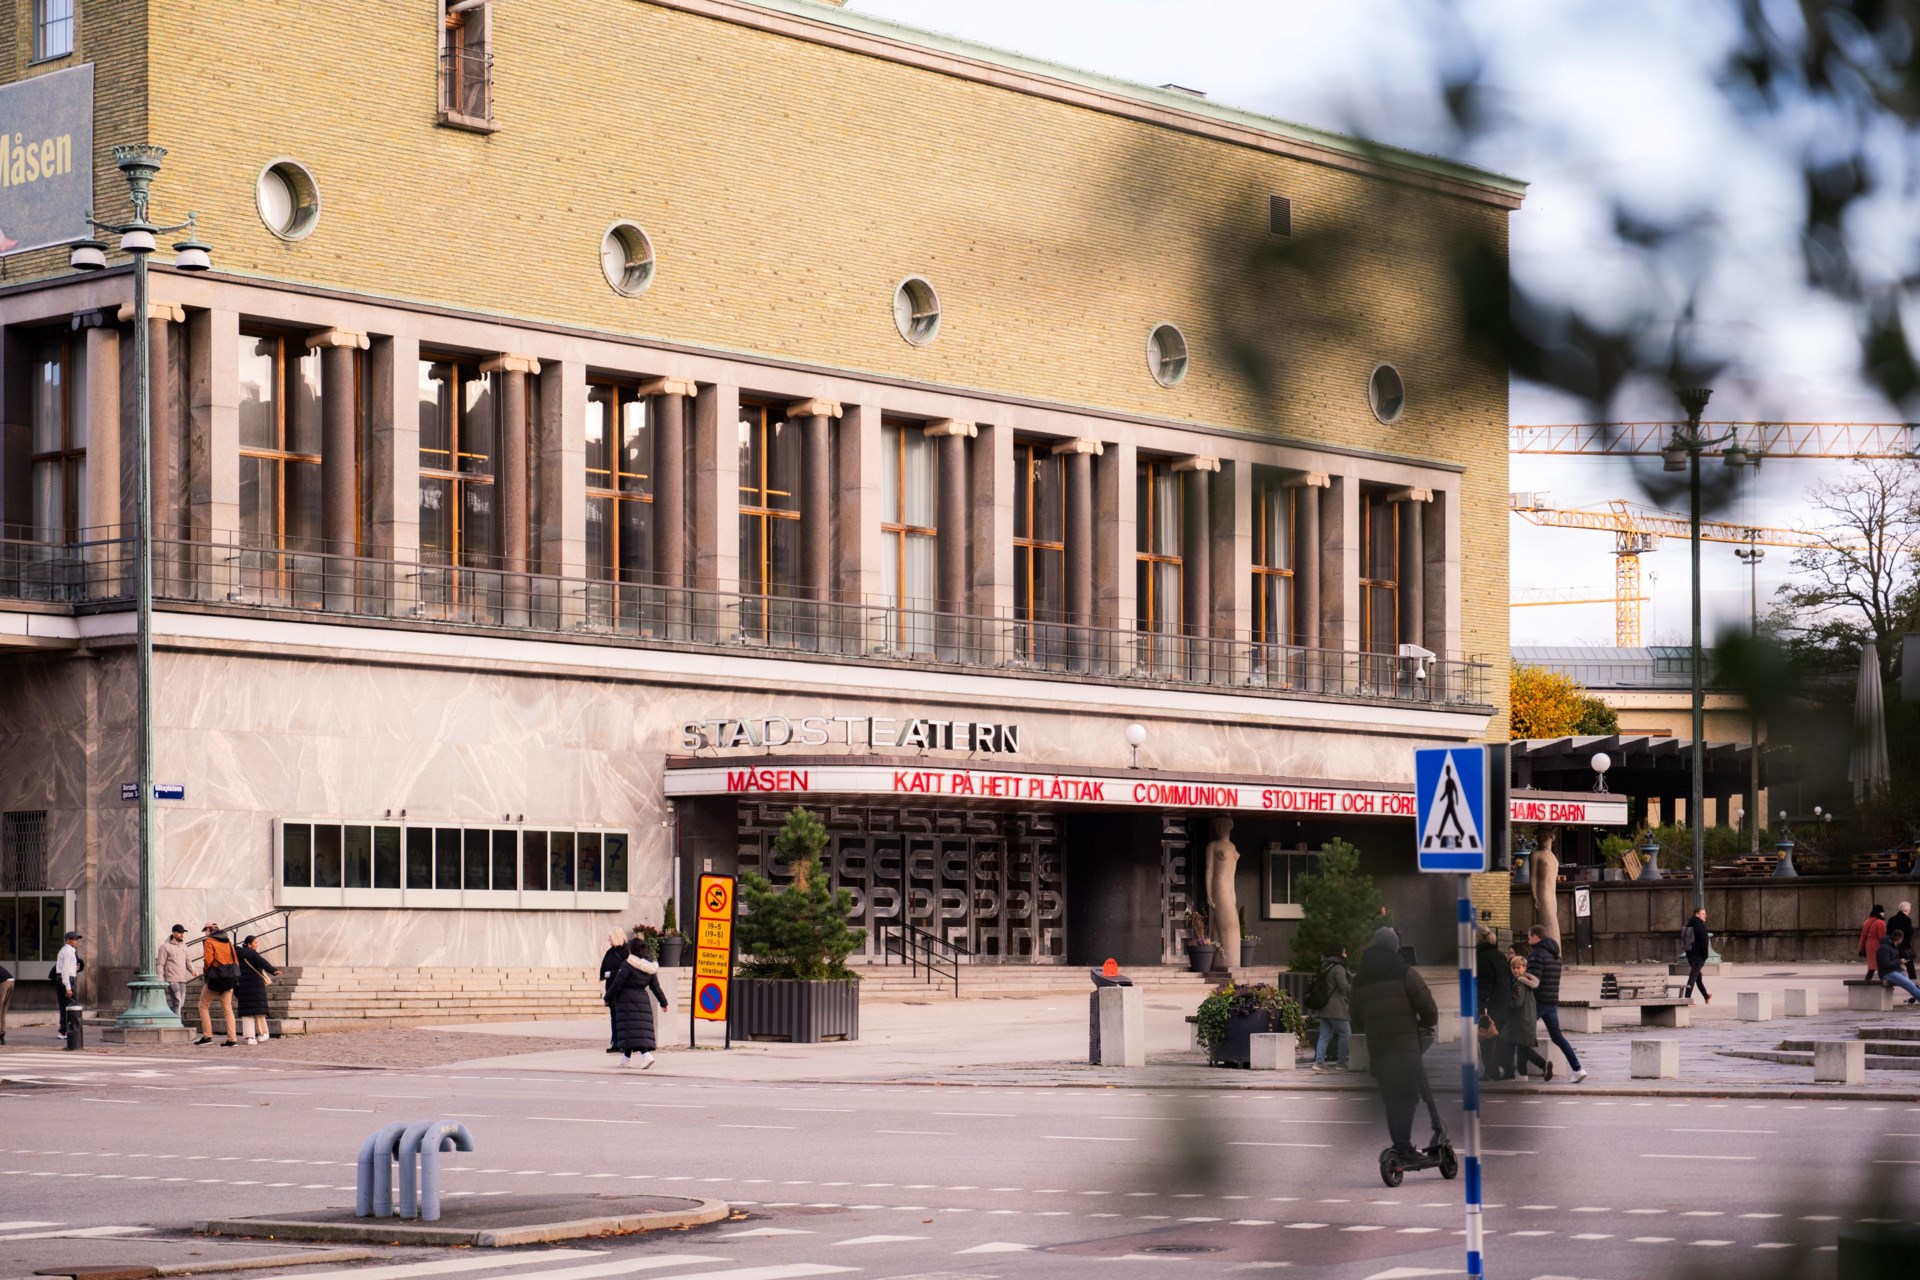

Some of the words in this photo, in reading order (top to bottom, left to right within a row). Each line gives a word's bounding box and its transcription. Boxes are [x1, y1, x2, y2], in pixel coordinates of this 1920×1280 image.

[681, 715, 1020, 753] STADSTEATERN
[727, 764, 809, 792] MÅSEN
[893, 771, 945, 793] KATT
[952, 769, 975, 795] PÅ
[981, 775, 1023, 798] HETT
[1029, 774, 1105, 801] PLÅTTAK
[1133, 783, 1239, 807] COMMUNION
[1262, 789, 1337, 812] STOLTHET
[1342, 793, 1375, 813] OCH
[1550, 803, 1586, 822] BARN
[705, 930, 724, 939] (19-5)
